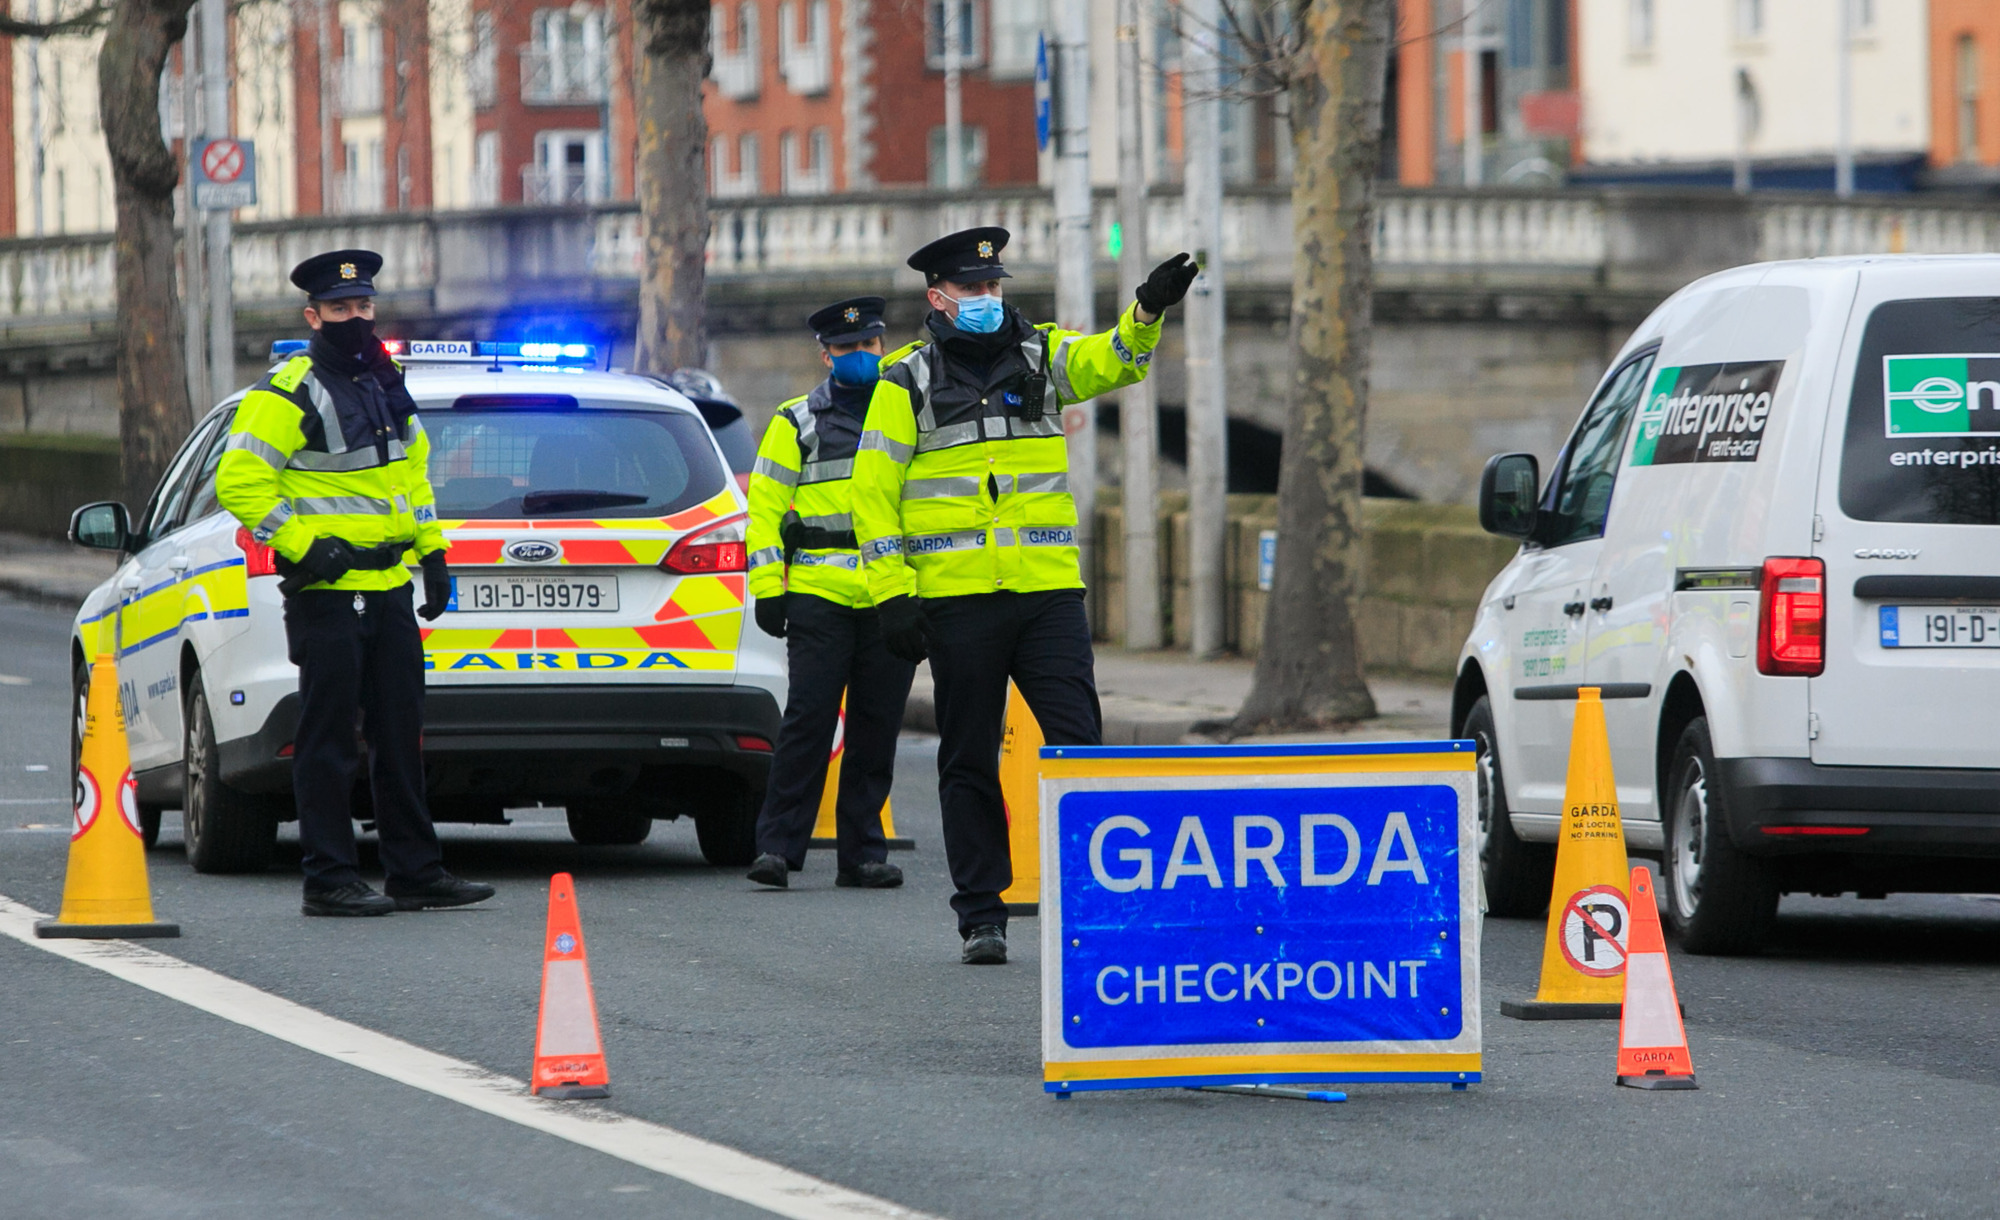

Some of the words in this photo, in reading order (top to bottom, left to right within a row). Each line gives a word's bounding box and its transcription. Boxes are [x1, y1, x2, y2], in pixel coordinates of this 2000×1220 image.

[412, 343, 468, 354] GARDA
[1642, 378, 1771, 449] enterprise
[1707, 437, 1760, 457] rent-a-car
[908, 536, 954, 551] GARDA
[1028, 530, 1073, 544] GARDA
[519, 544, 547, 557] Ford
[1853, 548, 1921, 560] CADDY
[473, 584, 601, 608] 131-D-19979
[1882, 630, 1898, 640] IRL
[1926, 615, 2000, 643] 191-D-
[424, 652, 693, 671] ARDA
[1571, 805, 1617, 818] GARDA
[1586, 821, 1616, 829] LOCTAR
[1585, 831, 1618, 839] PARKING
[1088, 811, 1430, 893] GARDA
[1095, 960, 1427, 1006] CHECKPOINT
[1633, 1052, 1676, 1063] GARDA
[549, 1063, 589, 1074] GARDA
